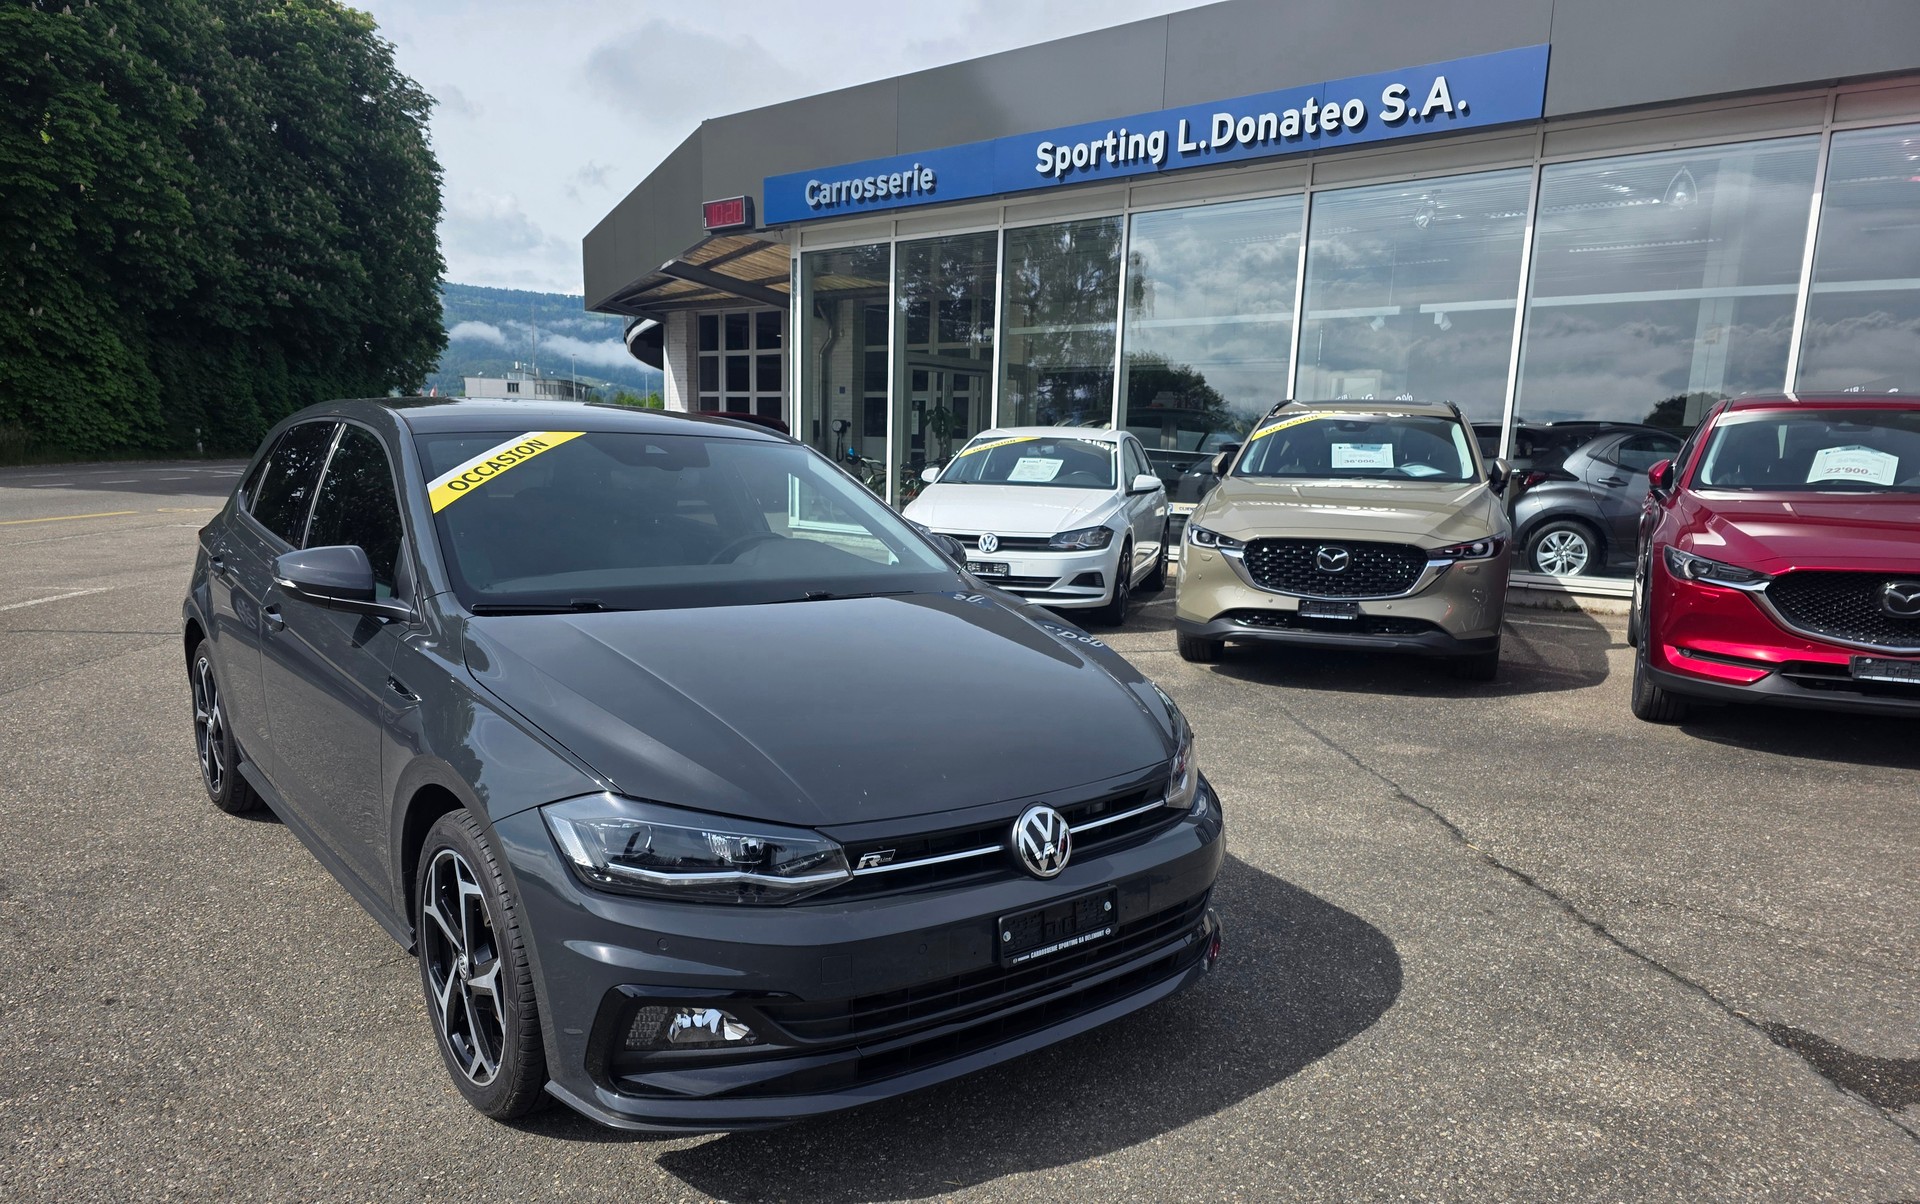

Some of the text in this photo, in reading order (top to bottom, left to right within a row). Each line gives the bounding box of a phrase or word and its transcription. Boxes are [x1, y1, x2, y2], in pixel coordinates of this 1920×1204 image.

[1035, 127, 1166, 178] Sporting
[1379, 75, 1468, 122] S.A.
[805, 163, 935, 206] Carrosserie
[446, 439, 550, 492] OCCASION
[1030, 944, 1058, 959] CARROSSERIE
